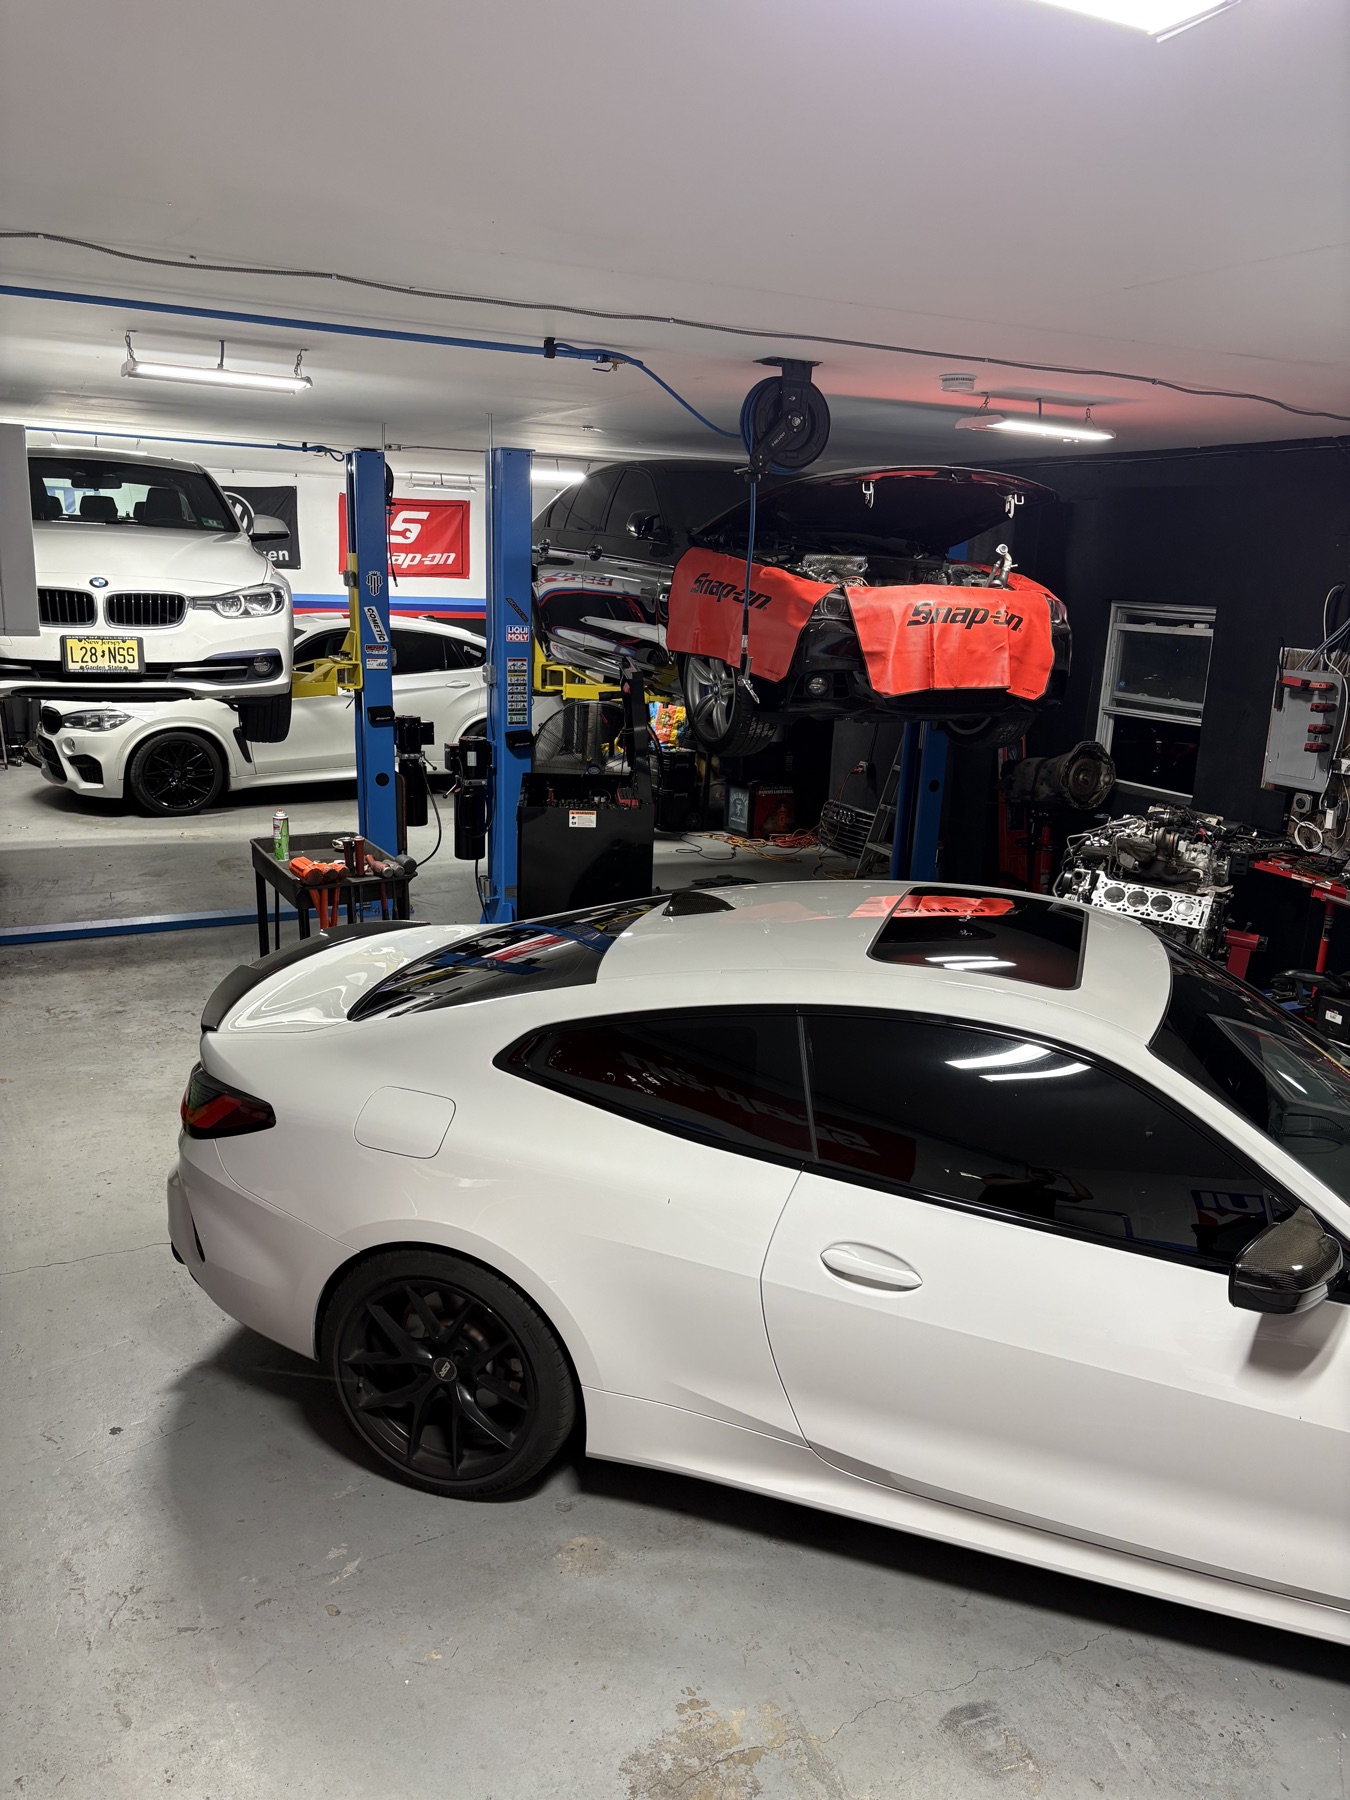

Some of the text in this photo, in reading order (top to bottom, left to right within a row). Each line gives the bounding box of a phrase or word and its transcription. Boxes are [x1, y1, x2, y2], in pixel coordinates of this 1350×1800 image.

[387, 552, 456, 569] ap-on
[906, 600, 1024, 632] Snap-on
[508, 626, 528, 634] LIQUI
[100, 638, 122, 646] Jersey
[70, 646, 135, 664] L28 NSS
